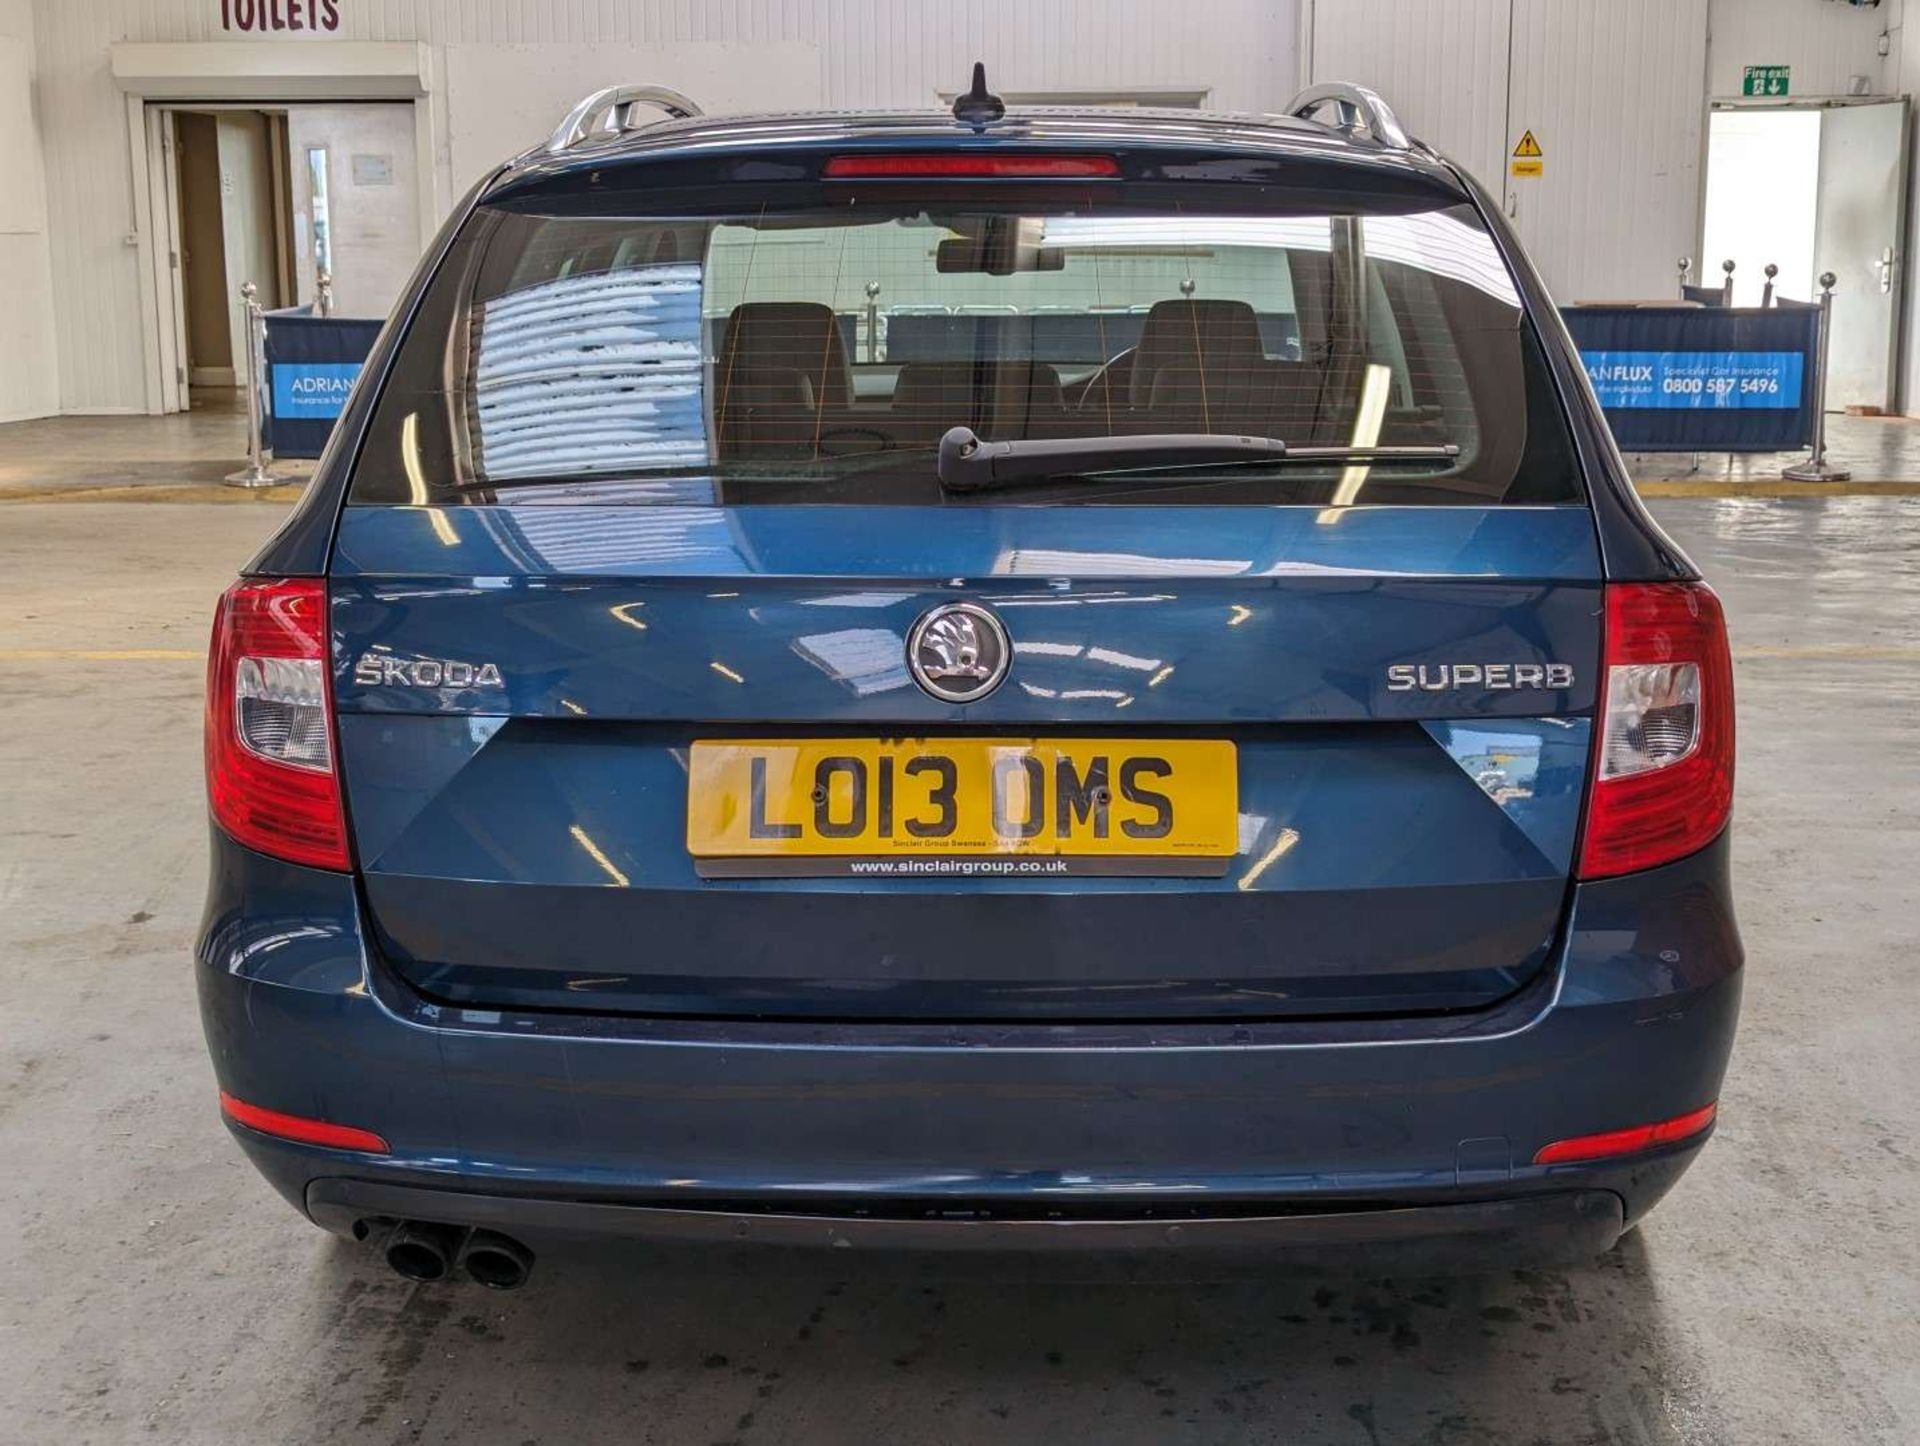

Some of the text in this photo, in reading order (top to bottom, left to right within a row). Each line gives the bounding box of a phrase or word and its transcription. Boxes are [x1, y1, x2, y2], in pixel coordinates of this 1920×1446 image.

[1745, 66, 1790, 79] Fire exit
[1731, 366, 1779, 377] Insurance
[1663, 378, 1778, 394] 0800 587 5496
[355, 653, 505, 689] ŠKODA
[1387, 663, 1575, 691] SUPERB
[749, 755, 1174, 840] LO13 OMS
[893, 839, 922, 847] Sinclair
[925, 840, 949, 848] Group
[850, 860, 1068, 874] www.sinclairgroup.co.uk
